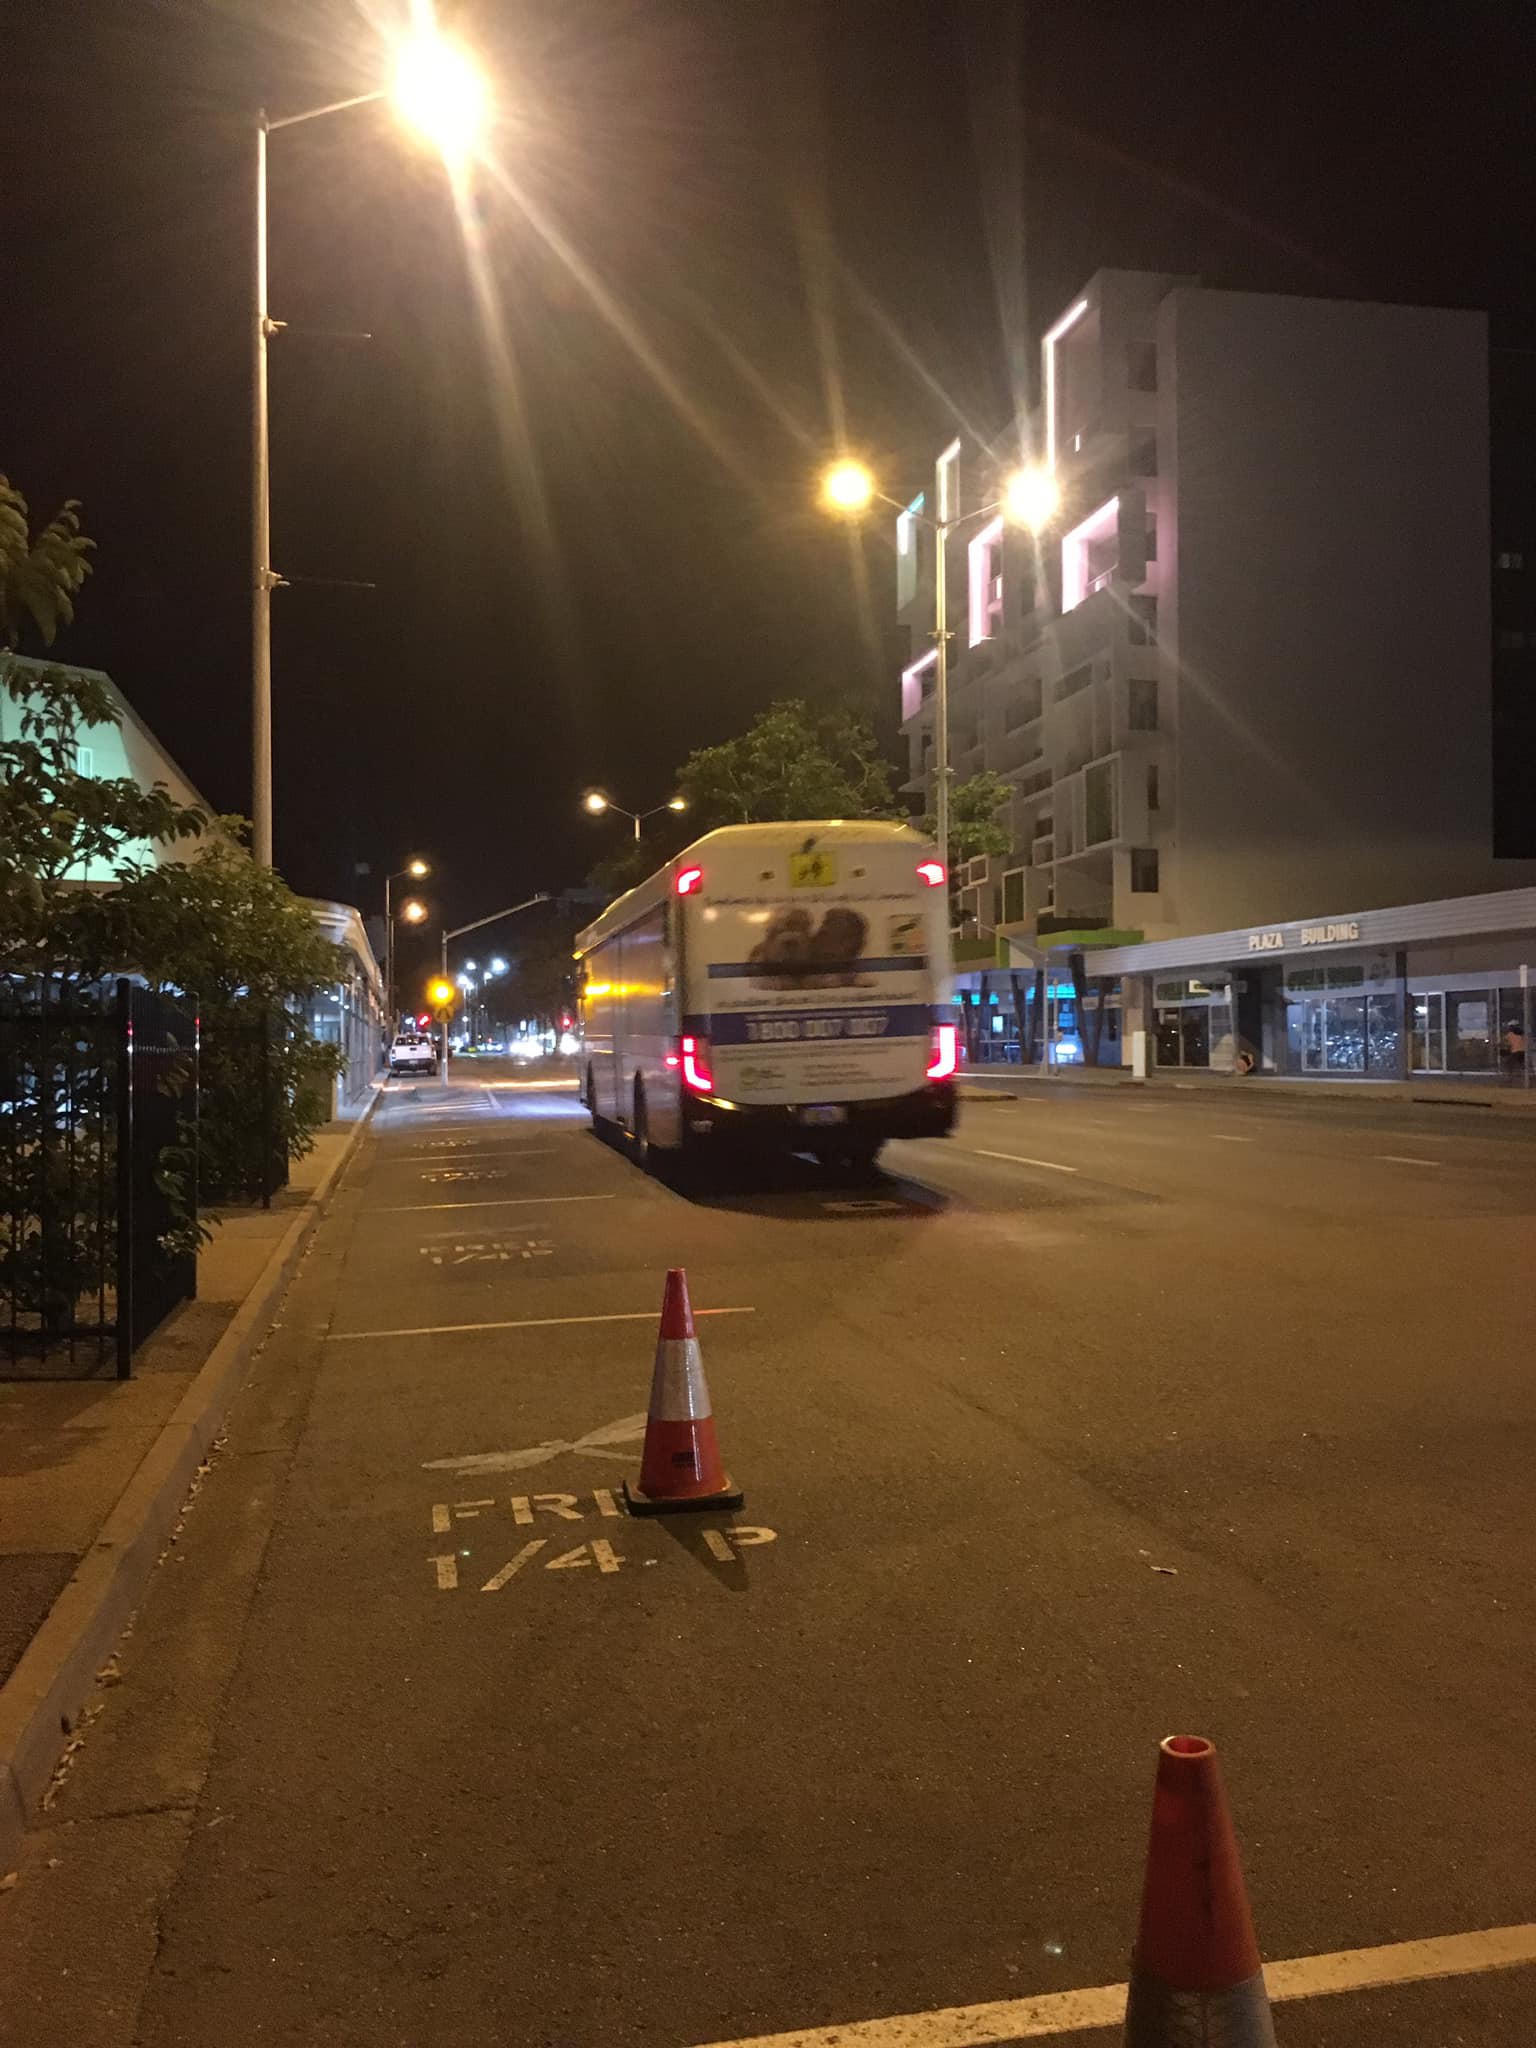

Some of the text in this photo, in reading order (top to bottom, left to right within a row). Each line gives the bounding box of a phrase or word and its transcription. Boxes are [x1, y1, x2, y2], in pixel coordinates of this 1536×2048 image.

[1249, 924, 1358, 950] PLAZA BUILDING
[701, 1525, 778, 1562] P
